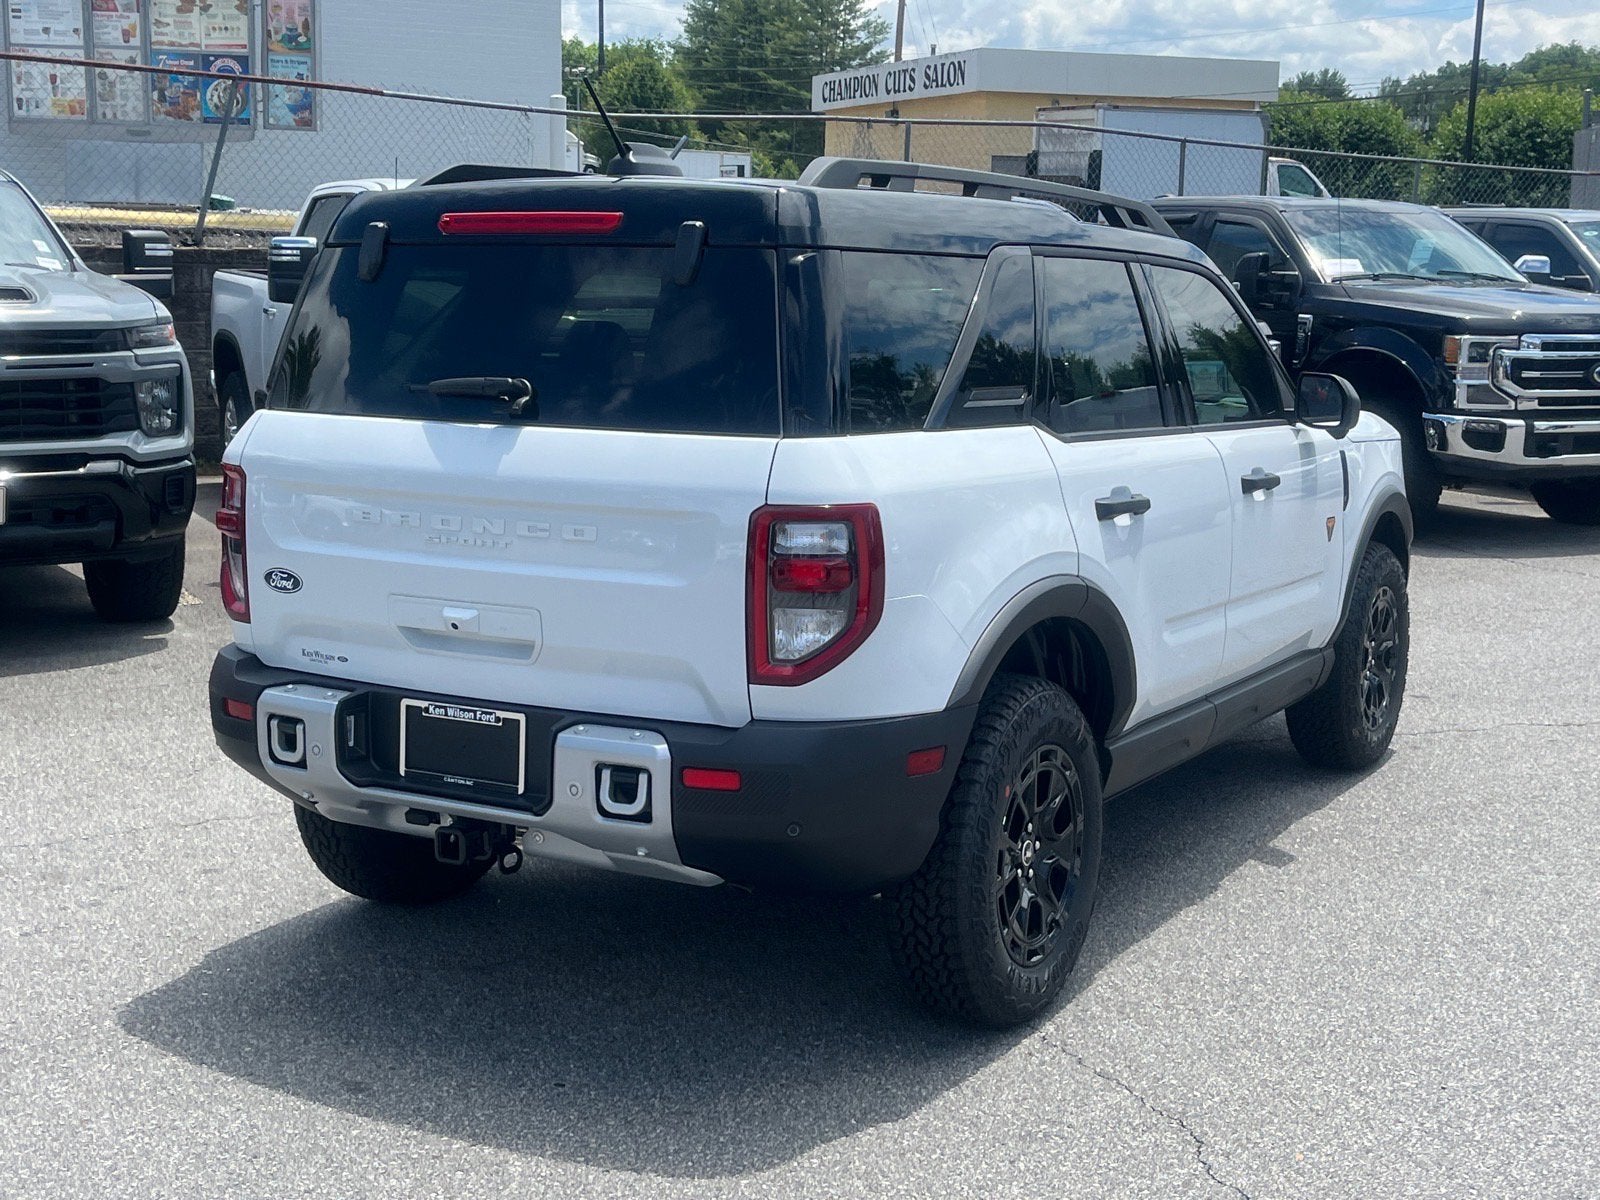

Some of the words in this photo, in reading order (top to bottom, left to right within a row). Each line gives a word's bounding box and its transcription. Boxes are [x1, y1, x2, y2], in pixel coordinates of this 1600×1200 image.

[822, 73, 879, 103] CHAMPION
[885, 67, 917, 96] CUTS
[923, 60, 967, 90] SALON
[351, 509, 597, 541] BRONCO
[269, 570, 295, 591] Ford
[428, 704, 445, 716] Ken
[446, 706, 474, 720] Wilson
[476, 710, 496, 723] Ford
